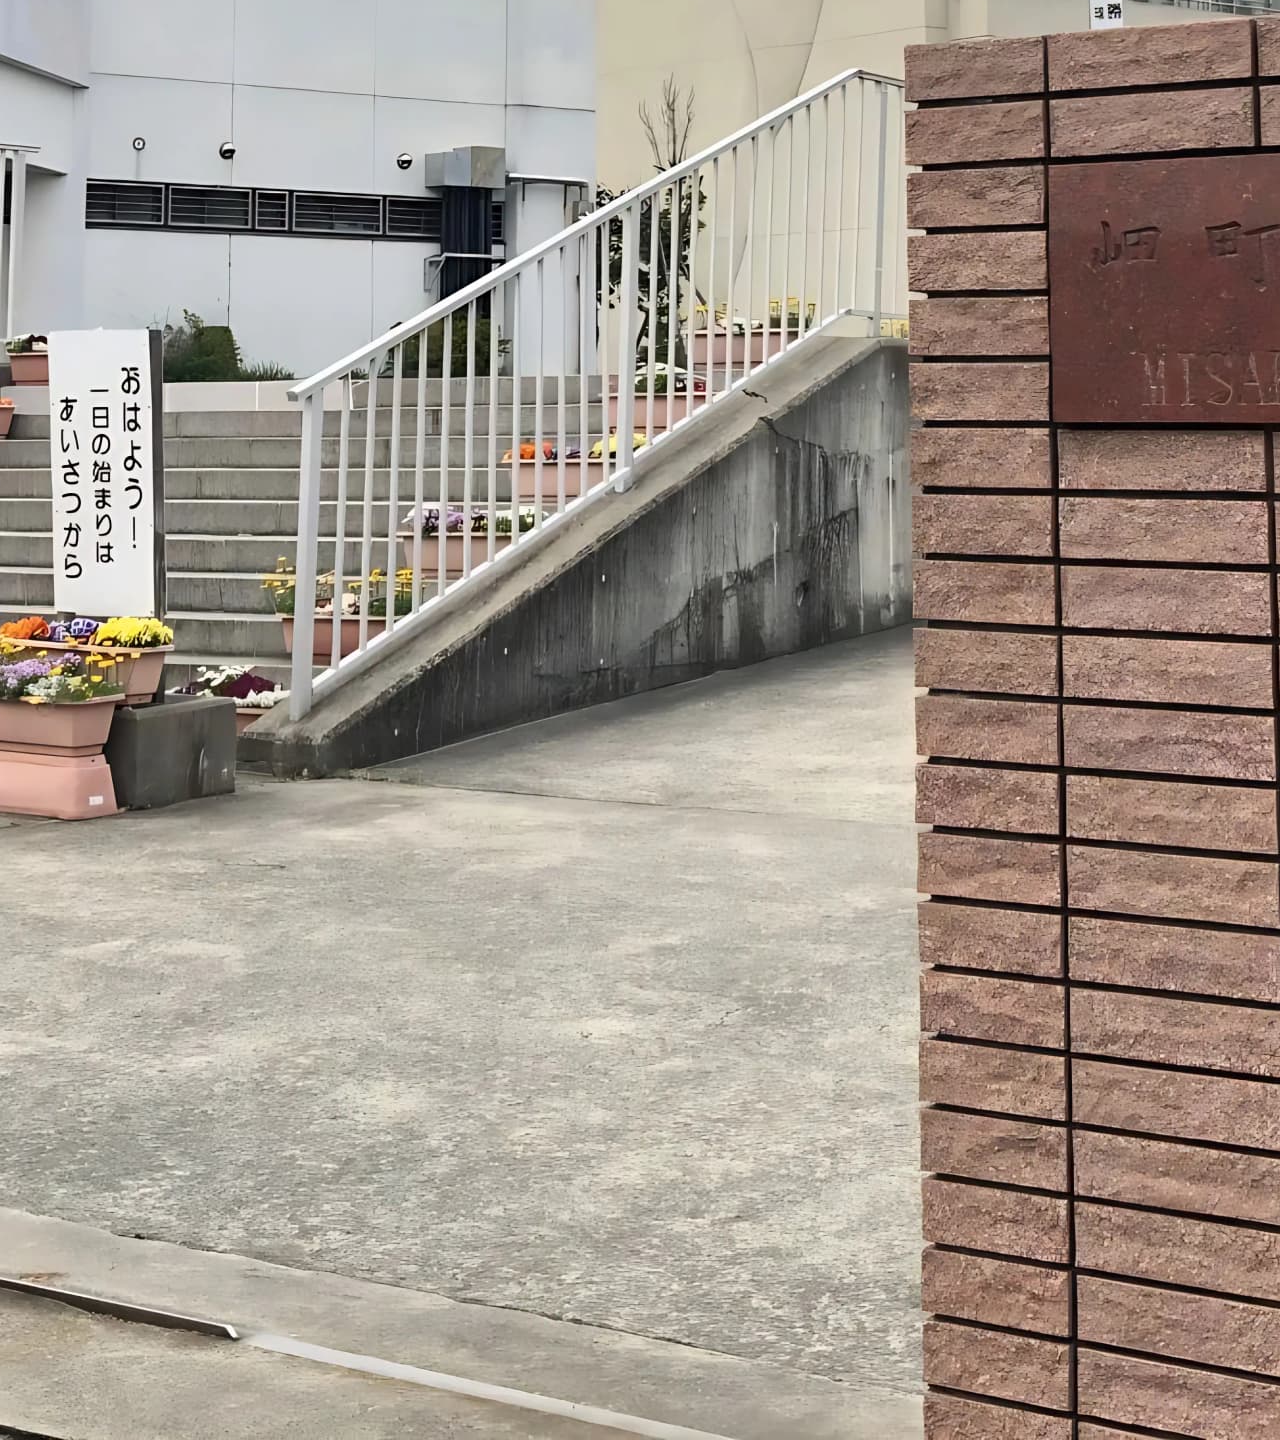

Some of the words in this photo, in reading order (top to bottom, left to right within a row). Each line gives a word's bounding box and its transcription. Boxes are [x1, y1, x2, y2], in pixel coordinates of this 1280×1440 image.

[59, 396, 83, 579] あいさつから
[90, 389, 114, 564] 一日の始まりは
